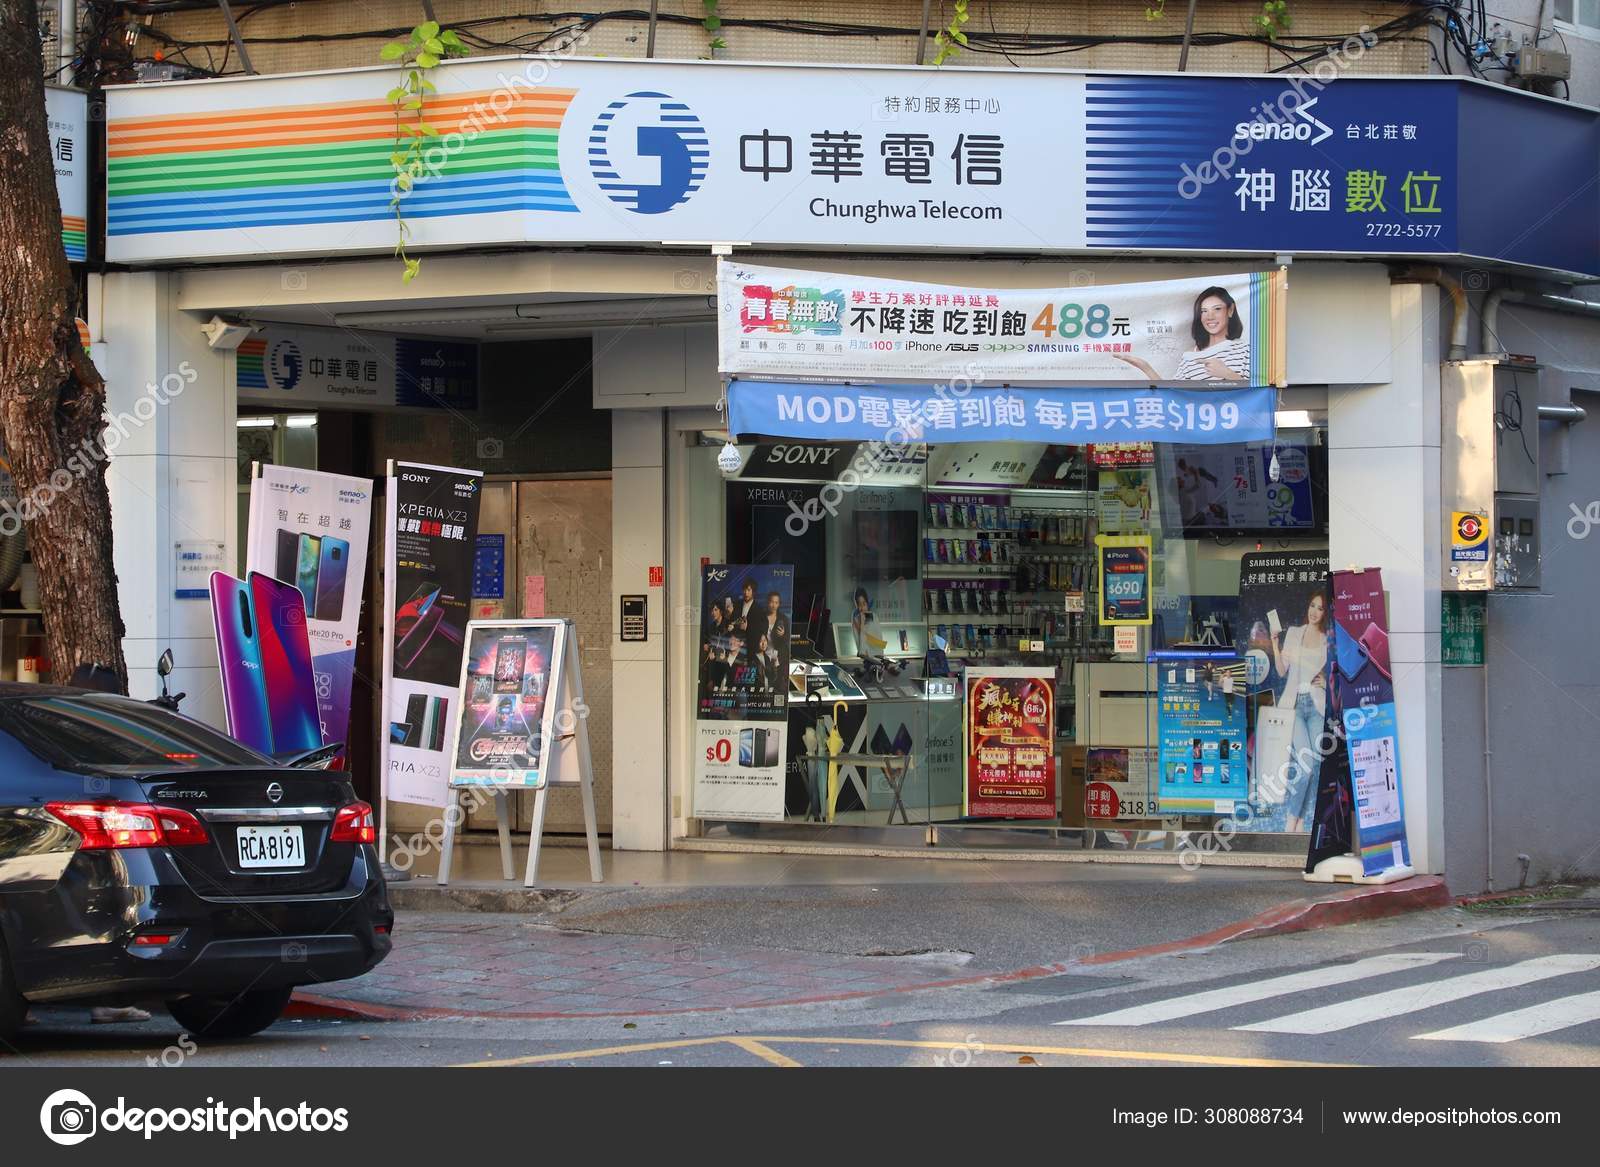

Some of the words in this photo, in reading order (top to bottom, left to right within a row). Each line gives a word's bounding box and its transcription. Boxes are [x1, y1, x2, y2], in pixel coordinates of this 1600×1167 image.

[884, 96, 1001, 114] 特約服務中心
[1234, 122, 1312, 141] senao
[1346, 124, 1417, 140] 台北莊敬
[739, 128, 1005, 186] 中華電信
[1234, 167, 1442, 214] 神腦數位
[808, 197, 917, 224] Chunghwa
[919, 198, 1003, 221] Telecom
[1366, 223, 1442, 239] 2722-5577
[851, 290, 1000, 308] 學生方案好評再延長
[745, 297, 840, 323] 青春無敵
[850, 307, 935, 335] 不降速
[943, 309, 1027, 337] 吃到飽
[1032, 303, 1131, 340] 488元
[905, 341, 942, 352] iPhone
[945, 343, 979, 352] ASUS
[1027, 343, 1080, 353] SAMSUNG
[310, 356, 378, 382] 中華電信
[1034, 397, 1240, 431] 每月只要$199
[767, 445, 840, 465] SONY
[402, 473, 430, 484] SONY
[748, 488, 785, 501] XPERIA
[278, 508, 352, 530] 智在超越
[399, 502, 445, 519] XPERIA
[446, 509, 468, 523] XZ3
[1249, 558, 1286, 567] SAMSUNG
[1289, 558, 1315, 568] Galaxy
[1249, 572, 1296, 584] 好禮在中華
[1109, 582, 1140, 595] $690
[309, 629, 330, 639] ate20
[706, 738, 732, 762] $0
[418, 763, 441, 778] XZ3
[157, 789, 209, 798] SENTRA
[1119, 800, 1160, 817] $18,9
